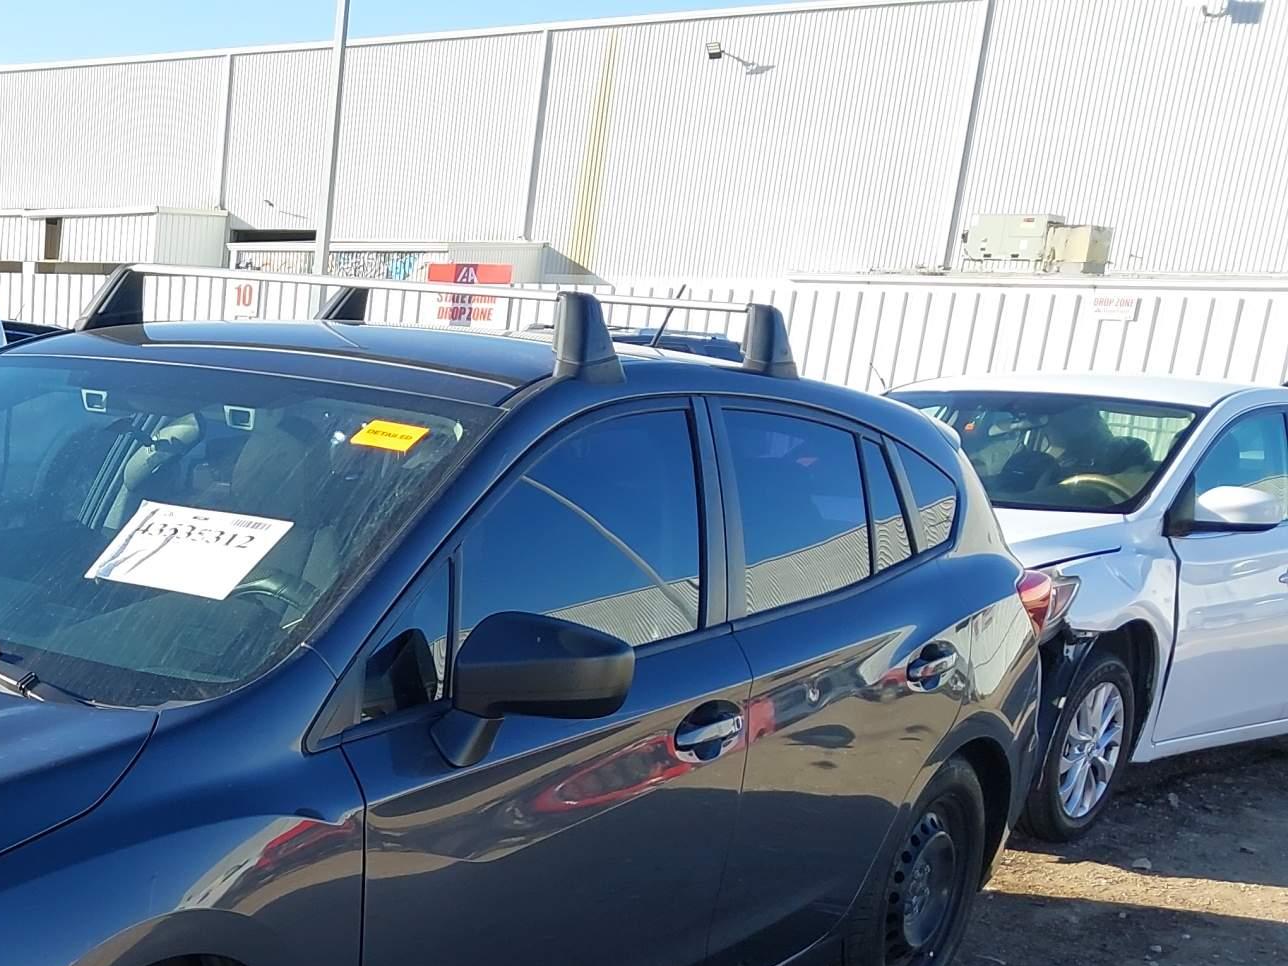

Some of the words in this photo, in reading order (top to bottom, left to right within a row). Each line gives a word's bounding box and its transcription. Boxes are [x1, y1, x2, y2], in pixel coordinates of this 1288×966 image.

[234, 284, 253, 307] 10
[437, 306, 466, 321] DROP
[466, 307, 495, 321] ZONE
[366, 428, 414, 441] DETAILED
